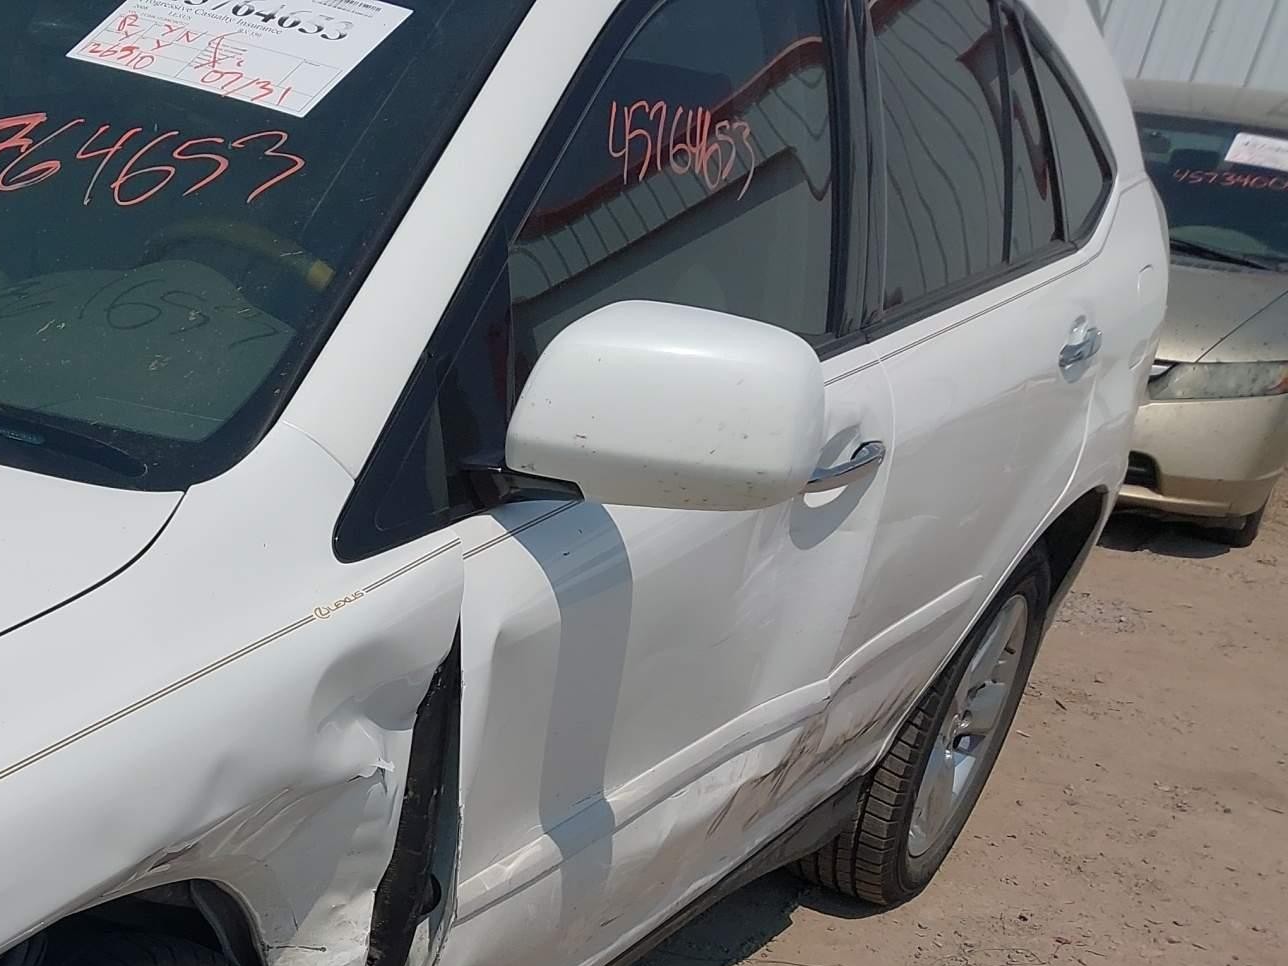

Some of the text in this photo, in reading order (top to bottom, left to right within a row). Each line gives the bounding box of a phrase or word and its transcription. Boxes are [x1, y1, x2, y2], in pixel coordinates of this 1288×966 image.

[236, 19, 283, 35] Insurance
[200, 69, 292, 107] 07/31
[608, 99, 756, 201] 45764653
